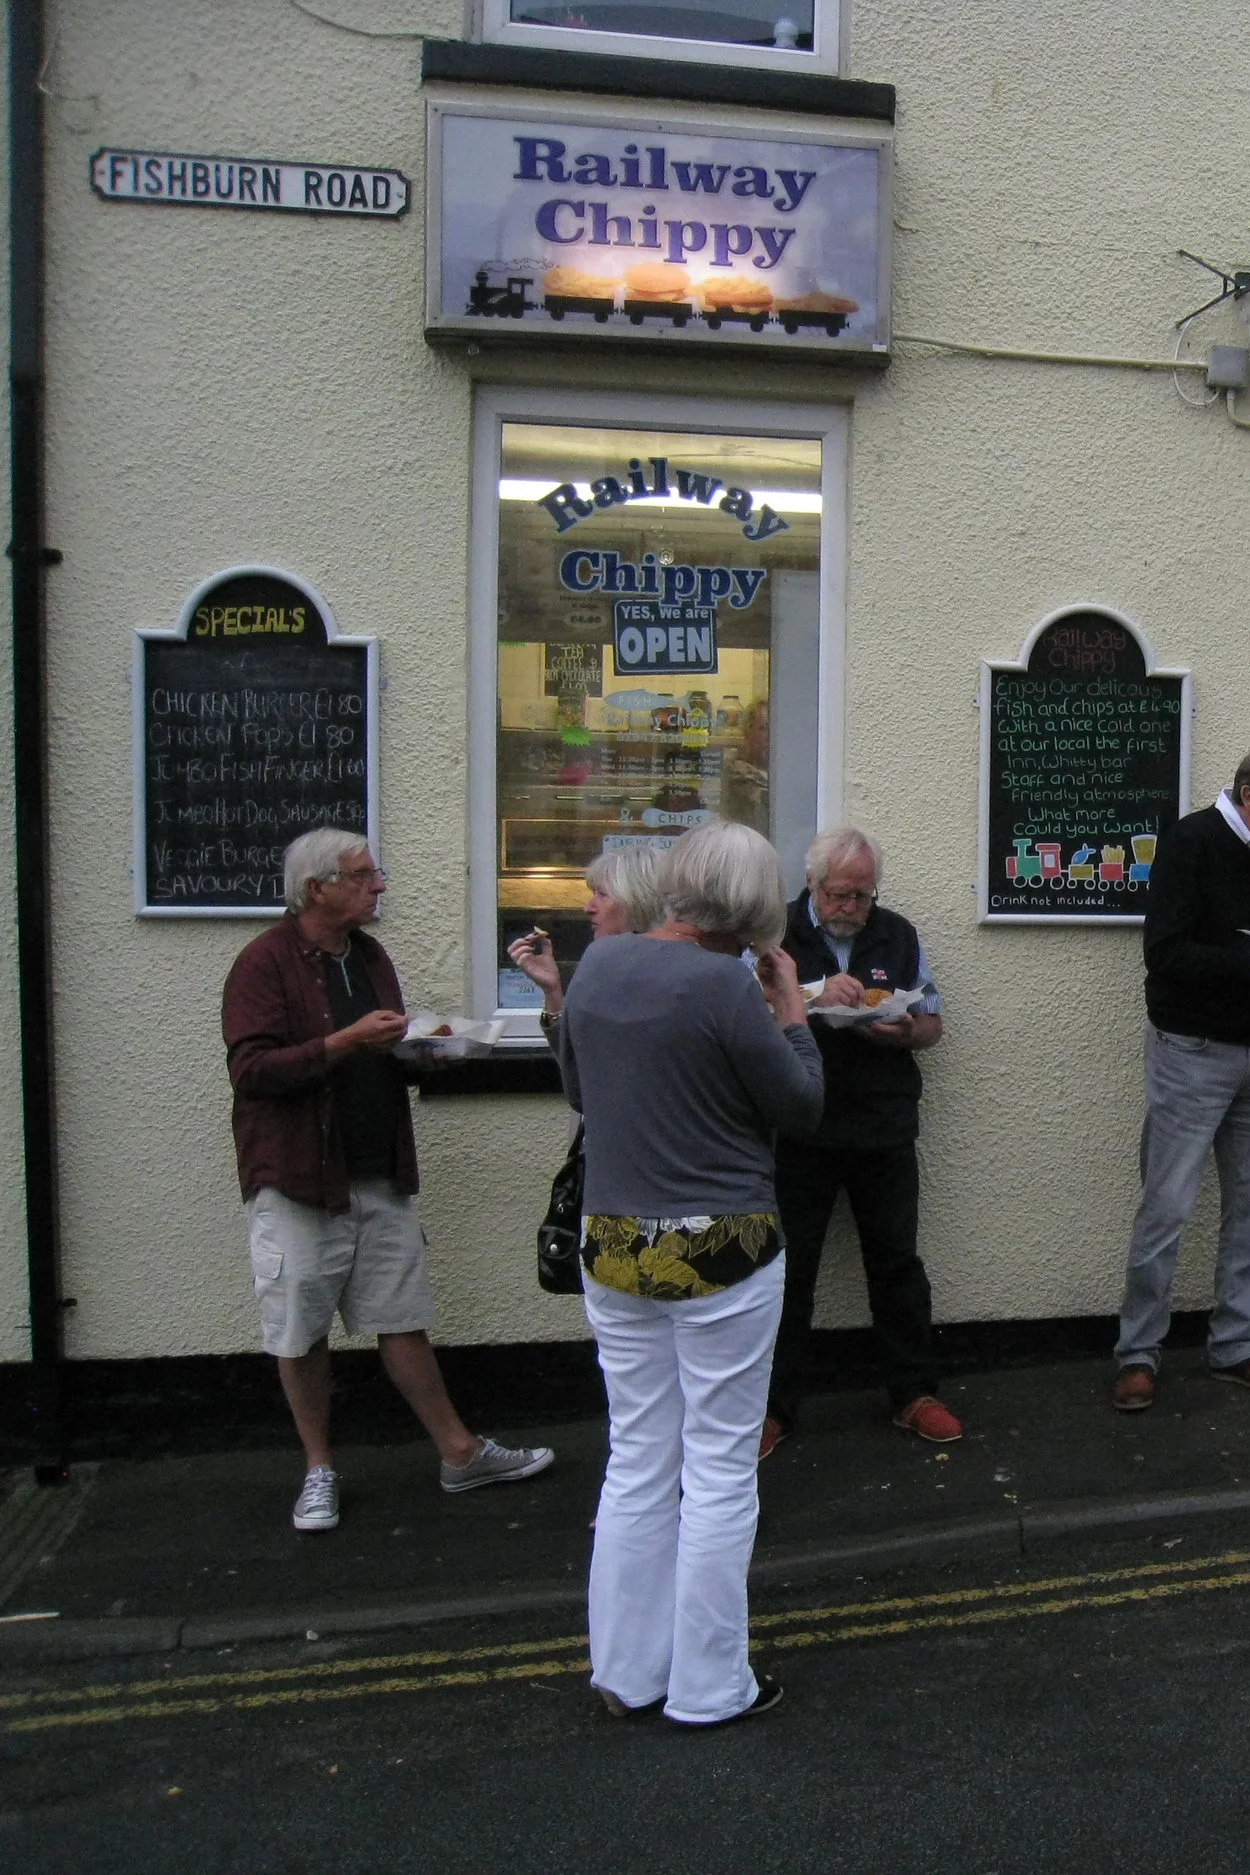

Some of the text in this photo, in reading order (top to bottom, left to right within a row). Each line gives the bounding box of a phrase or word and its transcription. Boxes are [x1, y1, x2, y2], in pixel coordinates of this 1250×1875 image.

[109, 155, 392, 209] FISHBURN ROAD
[512, 136, 817, 212] Railway
[534, 199, 796, 269] Chippy
[537, 457, 790, 541] Railway
[558, 549, 768, 609] Chippy
[621, 605, 709, 622] YES, We are
[619, 626, 711, 664] OPEN
[1043, 627, 1127, 650] Railway
[1049, 647, 1116, 674] Chippy
[995, 675, 1046, 703] Enjoy
[152, 688, 238, 718] CHICKEN
[1037, 697, 1070, 717] and
[1071, 698, 1115, 719] chips
[1117, 699, 1138, 714] at
[1045, 720, 1059, 732] a
[1060, 717, 1093, 732] nice
[1139, 720, 1171, 733] one
[997, 735, 1016, 752] at
[1020, 738, 1050, 751] our
[1053, 735, 1090, 751] local
[1095, 735, 1121, 750] the
[1100, 755, 1133, 769] bar
[1050, 773, 1086, 786] and
[1090, 771, 1124, 784] nice
[657, 813, 703, 825] CHIPS
[1075, 808, 1116, 821] more
[1065, 823, 1099, 839] you
[219, 838, 285, 871] BURGE
[151, 873, 264, 899] SAVOURY
[1030, 895, 1052, 907] not
